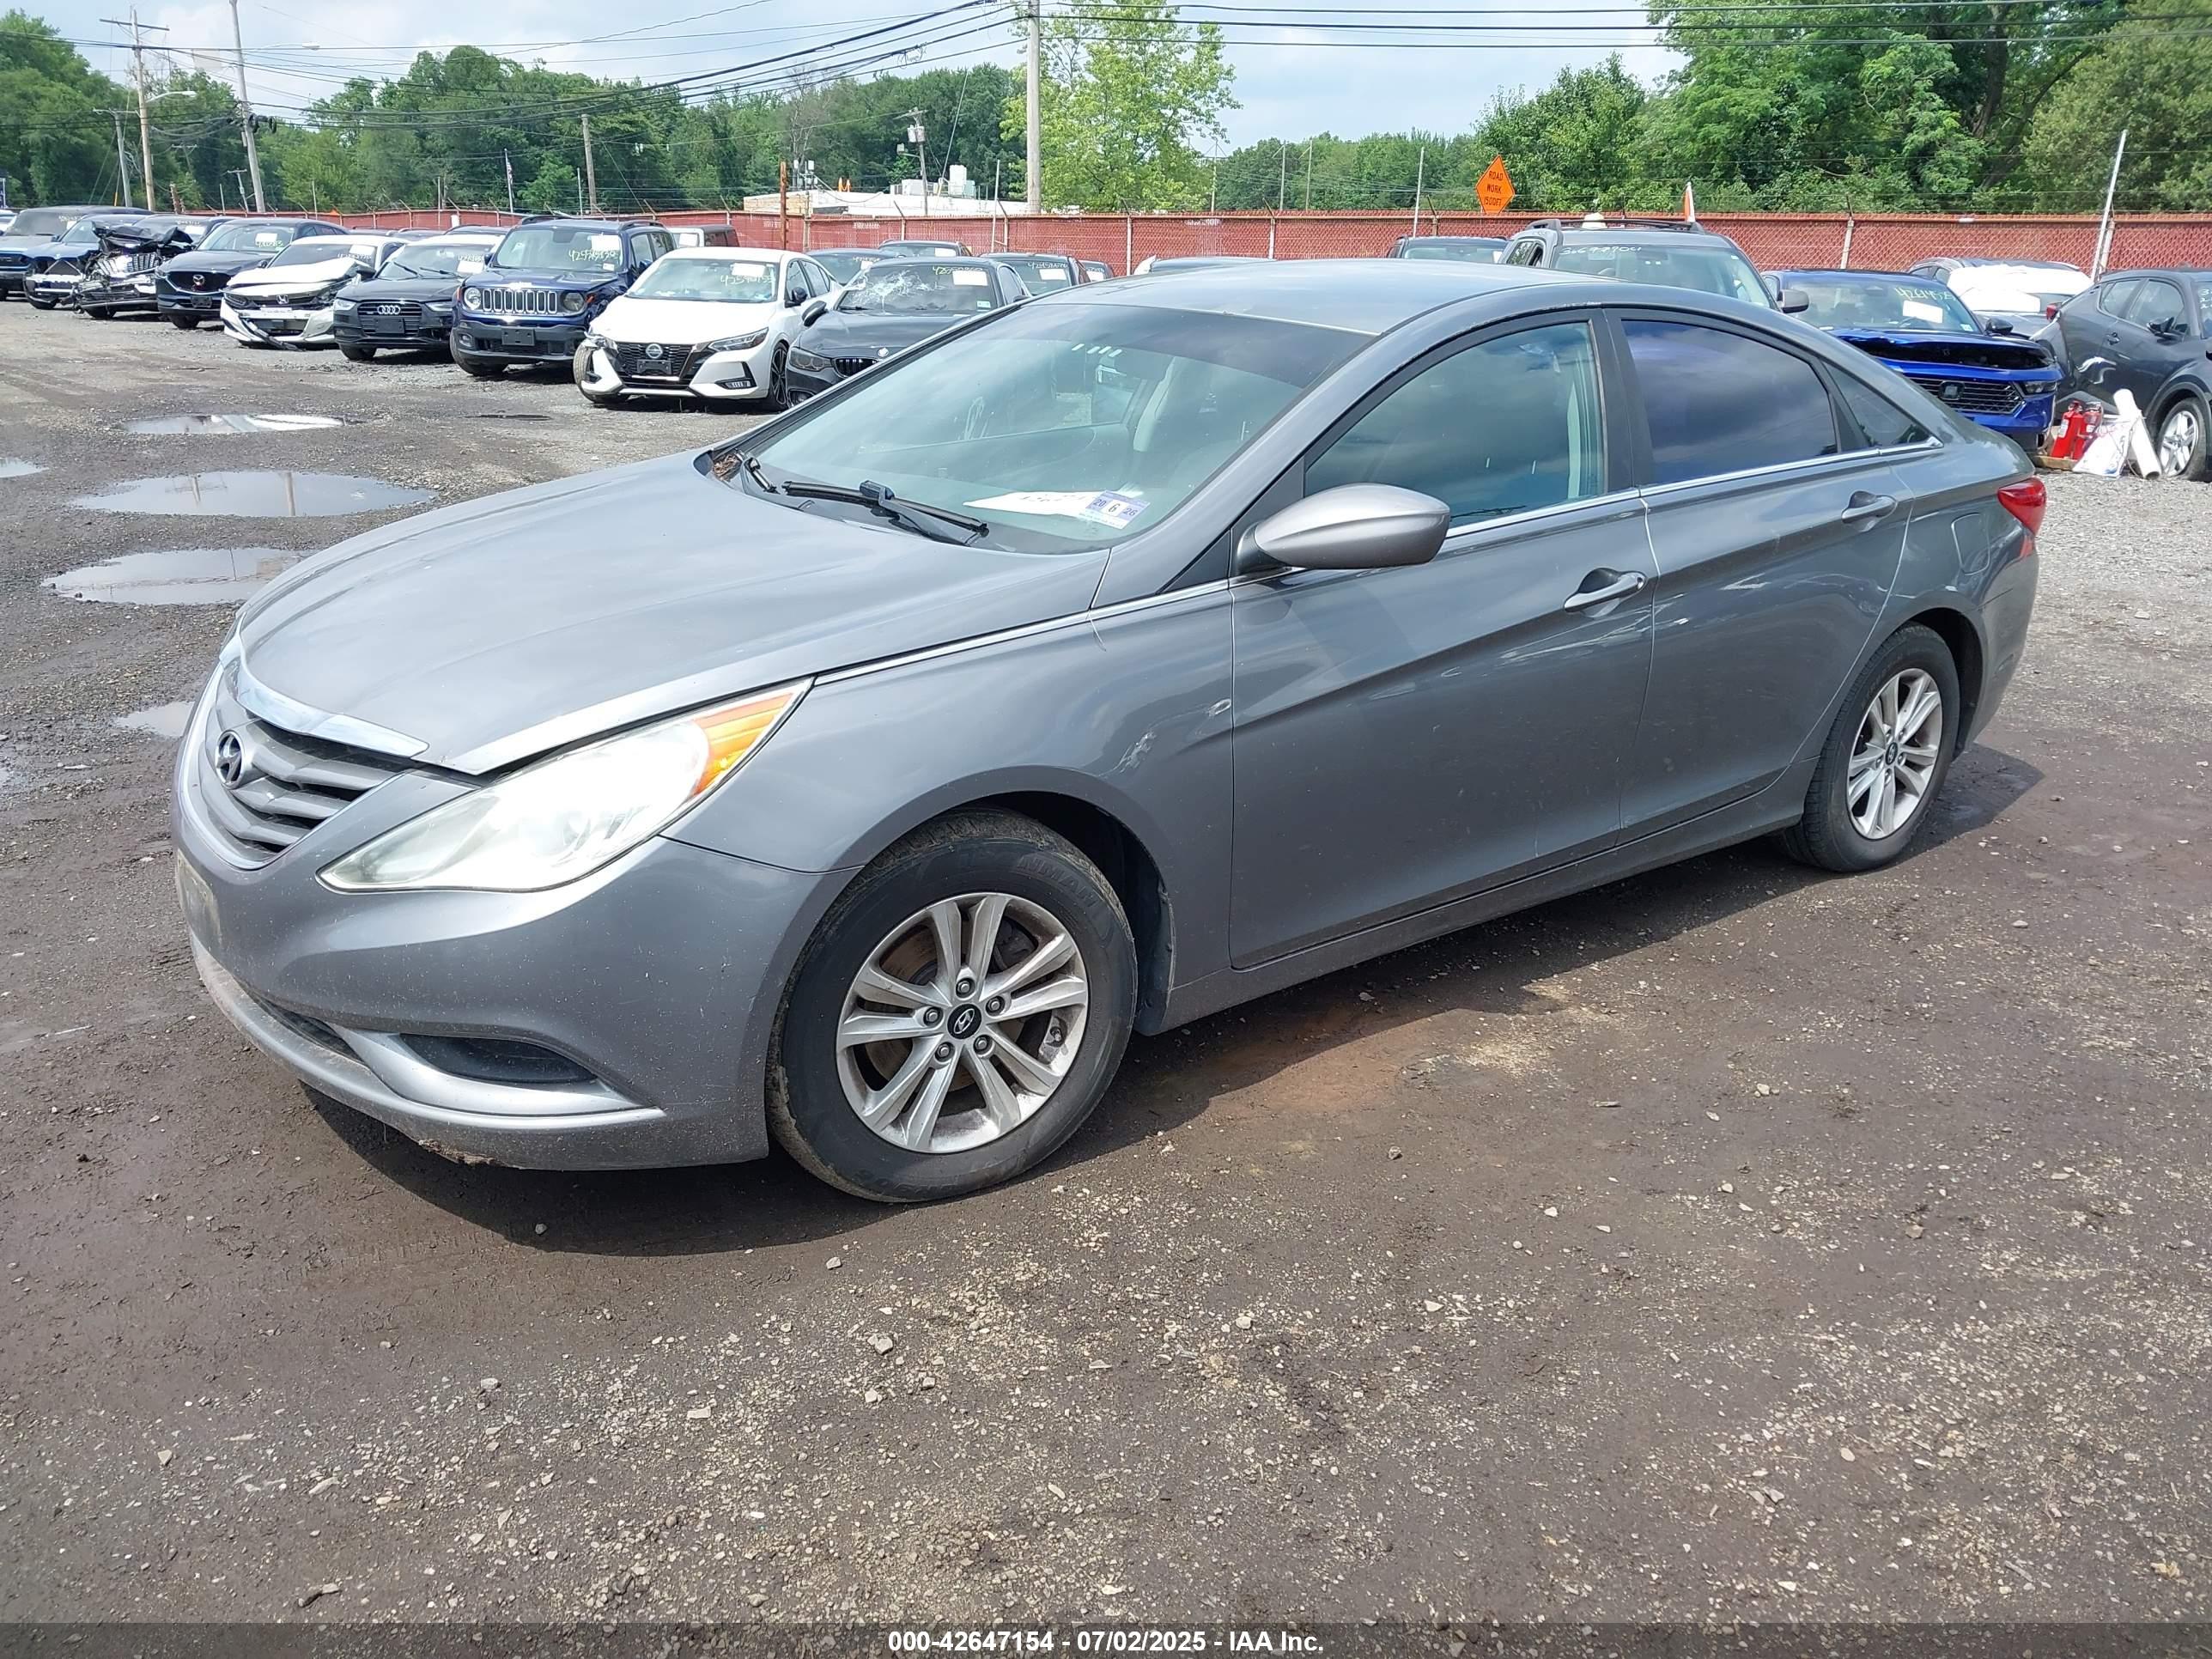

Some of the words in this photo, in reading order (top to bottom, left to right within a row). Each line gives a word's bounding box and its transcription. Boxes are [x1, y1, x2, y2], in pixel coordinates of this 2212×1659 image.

[1488, 170, 1504, 181] ROAD
[1486, 184, 1502, 194] WORK
[1108, 502, 1121, 513] 6
[1122, 507, 1138, 517] 26
